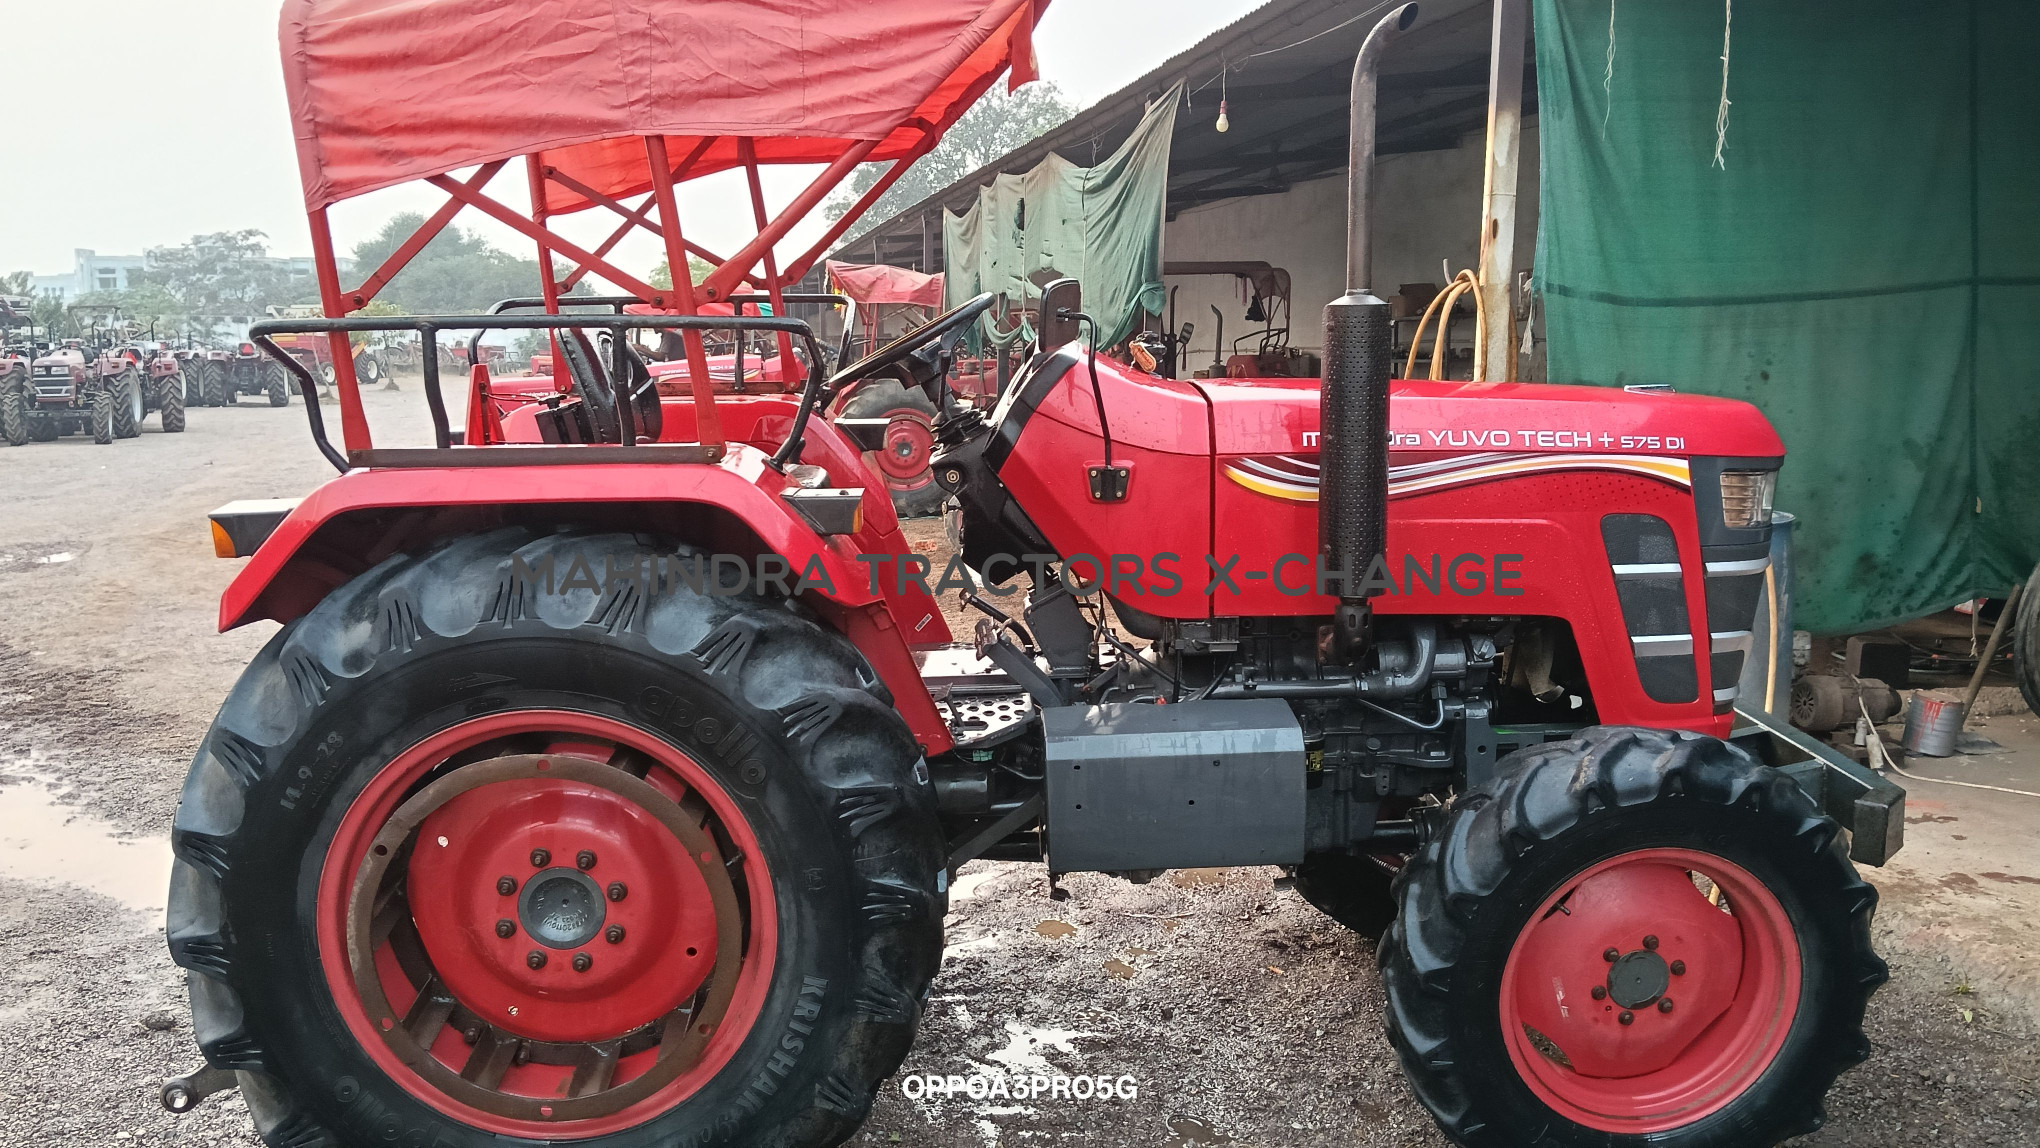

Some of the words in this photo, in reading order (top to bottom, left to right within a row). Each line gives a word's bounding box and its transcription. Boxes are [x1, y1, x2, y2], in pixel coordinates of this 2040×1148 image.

[1428, 430, 1511, 446] YUVO
[1517, 430, 1592, 447] TECH
[1598, 431, 1614, 447] +
[1620, 436, 1661, 449] 575
[1666, 437, 1685, 449] DI
[640, 685, 767, 785] apollo
[735, 974, 829, 1111] KRISHAK
